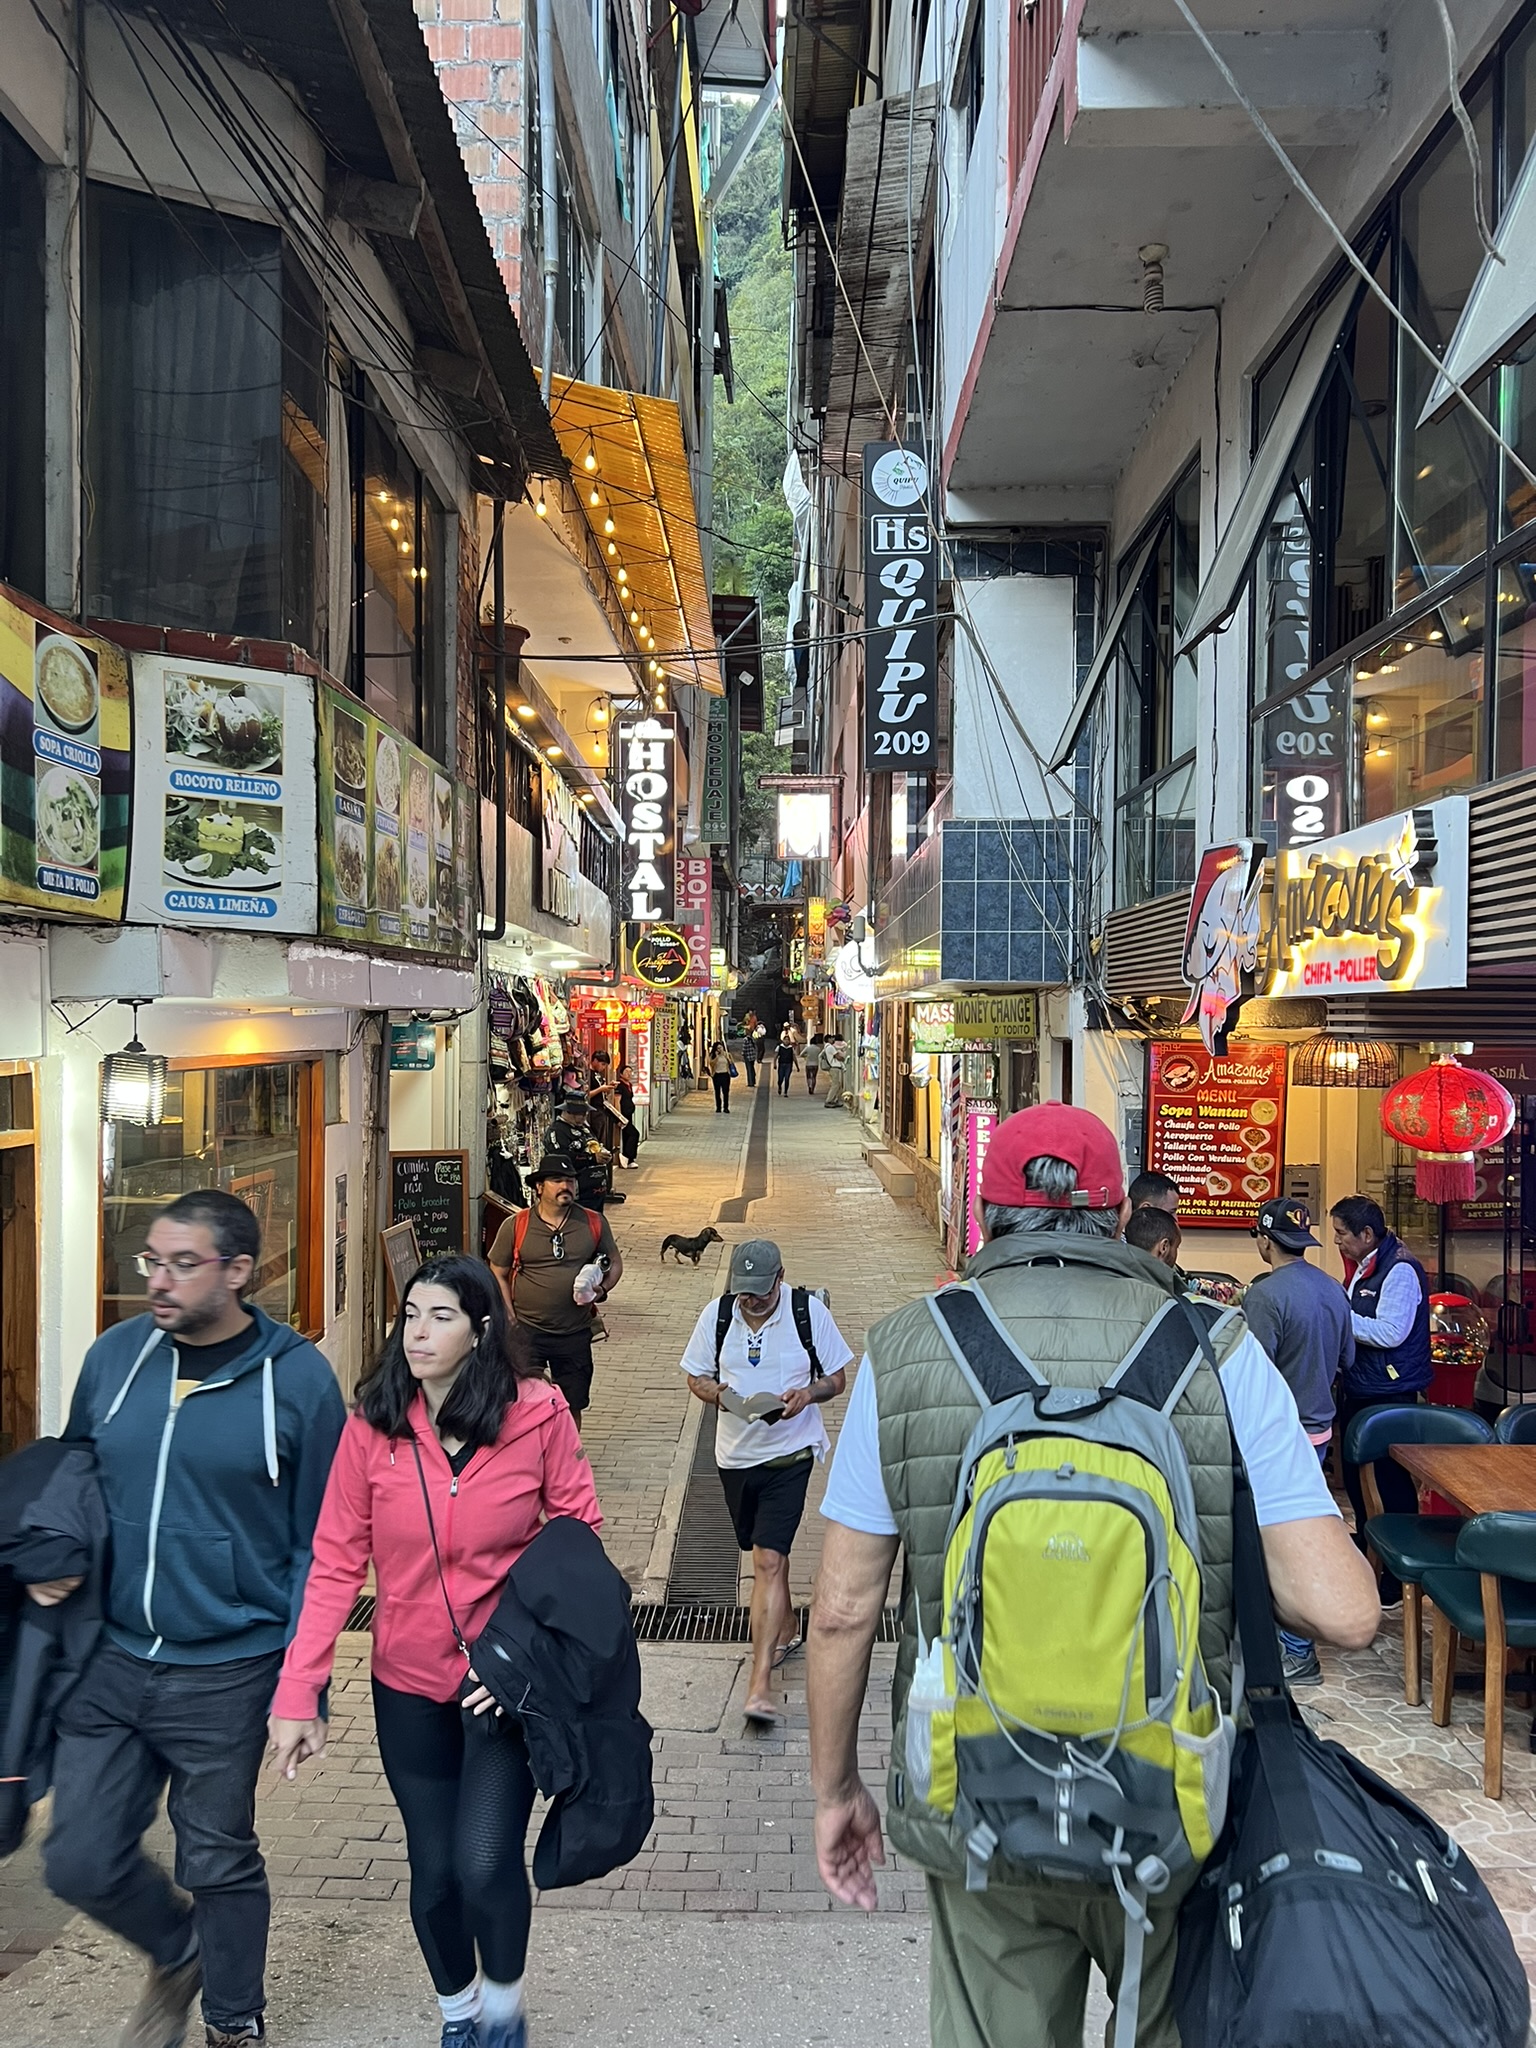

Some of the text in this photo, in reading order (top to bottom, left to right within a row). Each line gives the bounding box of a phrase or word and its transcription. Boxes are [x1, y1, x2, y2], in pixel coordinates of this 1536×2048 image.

[876, 518, 927, 550] Hs
[877, 558, 927, 724] QUIPU
[874, 731, 930, 755] 209
[39, 735, 99, 771] SOPA CRIOLLA
[706, 721, 724, 821] HOSPEDAJE
[175, 773, 278, 796] ROCOTO RELLENO
[626, 742, 667, 920] HOSTAL
[43, 870, 96, 895] DIETA DE POLLO
[169, 895, 269, 914] CAUSA LIMEÑA
[687, 860, 707, 970] BOTICA
[1304, 960, 1332, 985] CHIFA
[956, 998, 1031, 1024] MONEY CHANGE
[1003, 1025, 1030, 1035] TODITO
[965, 1043, 993, 1051] NAILS
[634, 1034, 649, 1094] OTICA
[1199, 1059, 1274, 1085] Amazonas
[967, 1100, 997, 1109] SALON
[1197, 1089, 1237, 1103] MENU
[1160, 1104, 1248, 1118] Sopa Wantan
[1164, 1119, 1240, 1131] Chaufa Con Pollo
[1163, 1131, 1213, 1141] Aeropuerto
[1200, 1143, 1217, 1151] Con
[1220, 1144, 1242, 1152] Pollo
[1163, 1152, 1246, 1164] Pollo Con Verduras
[1163, 1163, 1211, 1173] Combinado
[398, 1199, 416, 1210] Pollo
[1176, 1207, 1259, 1217] NTACTOS: 947462 784
[1193, 1199, 1207, 1207] POR
[1221, 1200, 1264, 1208] PREFERENCI
